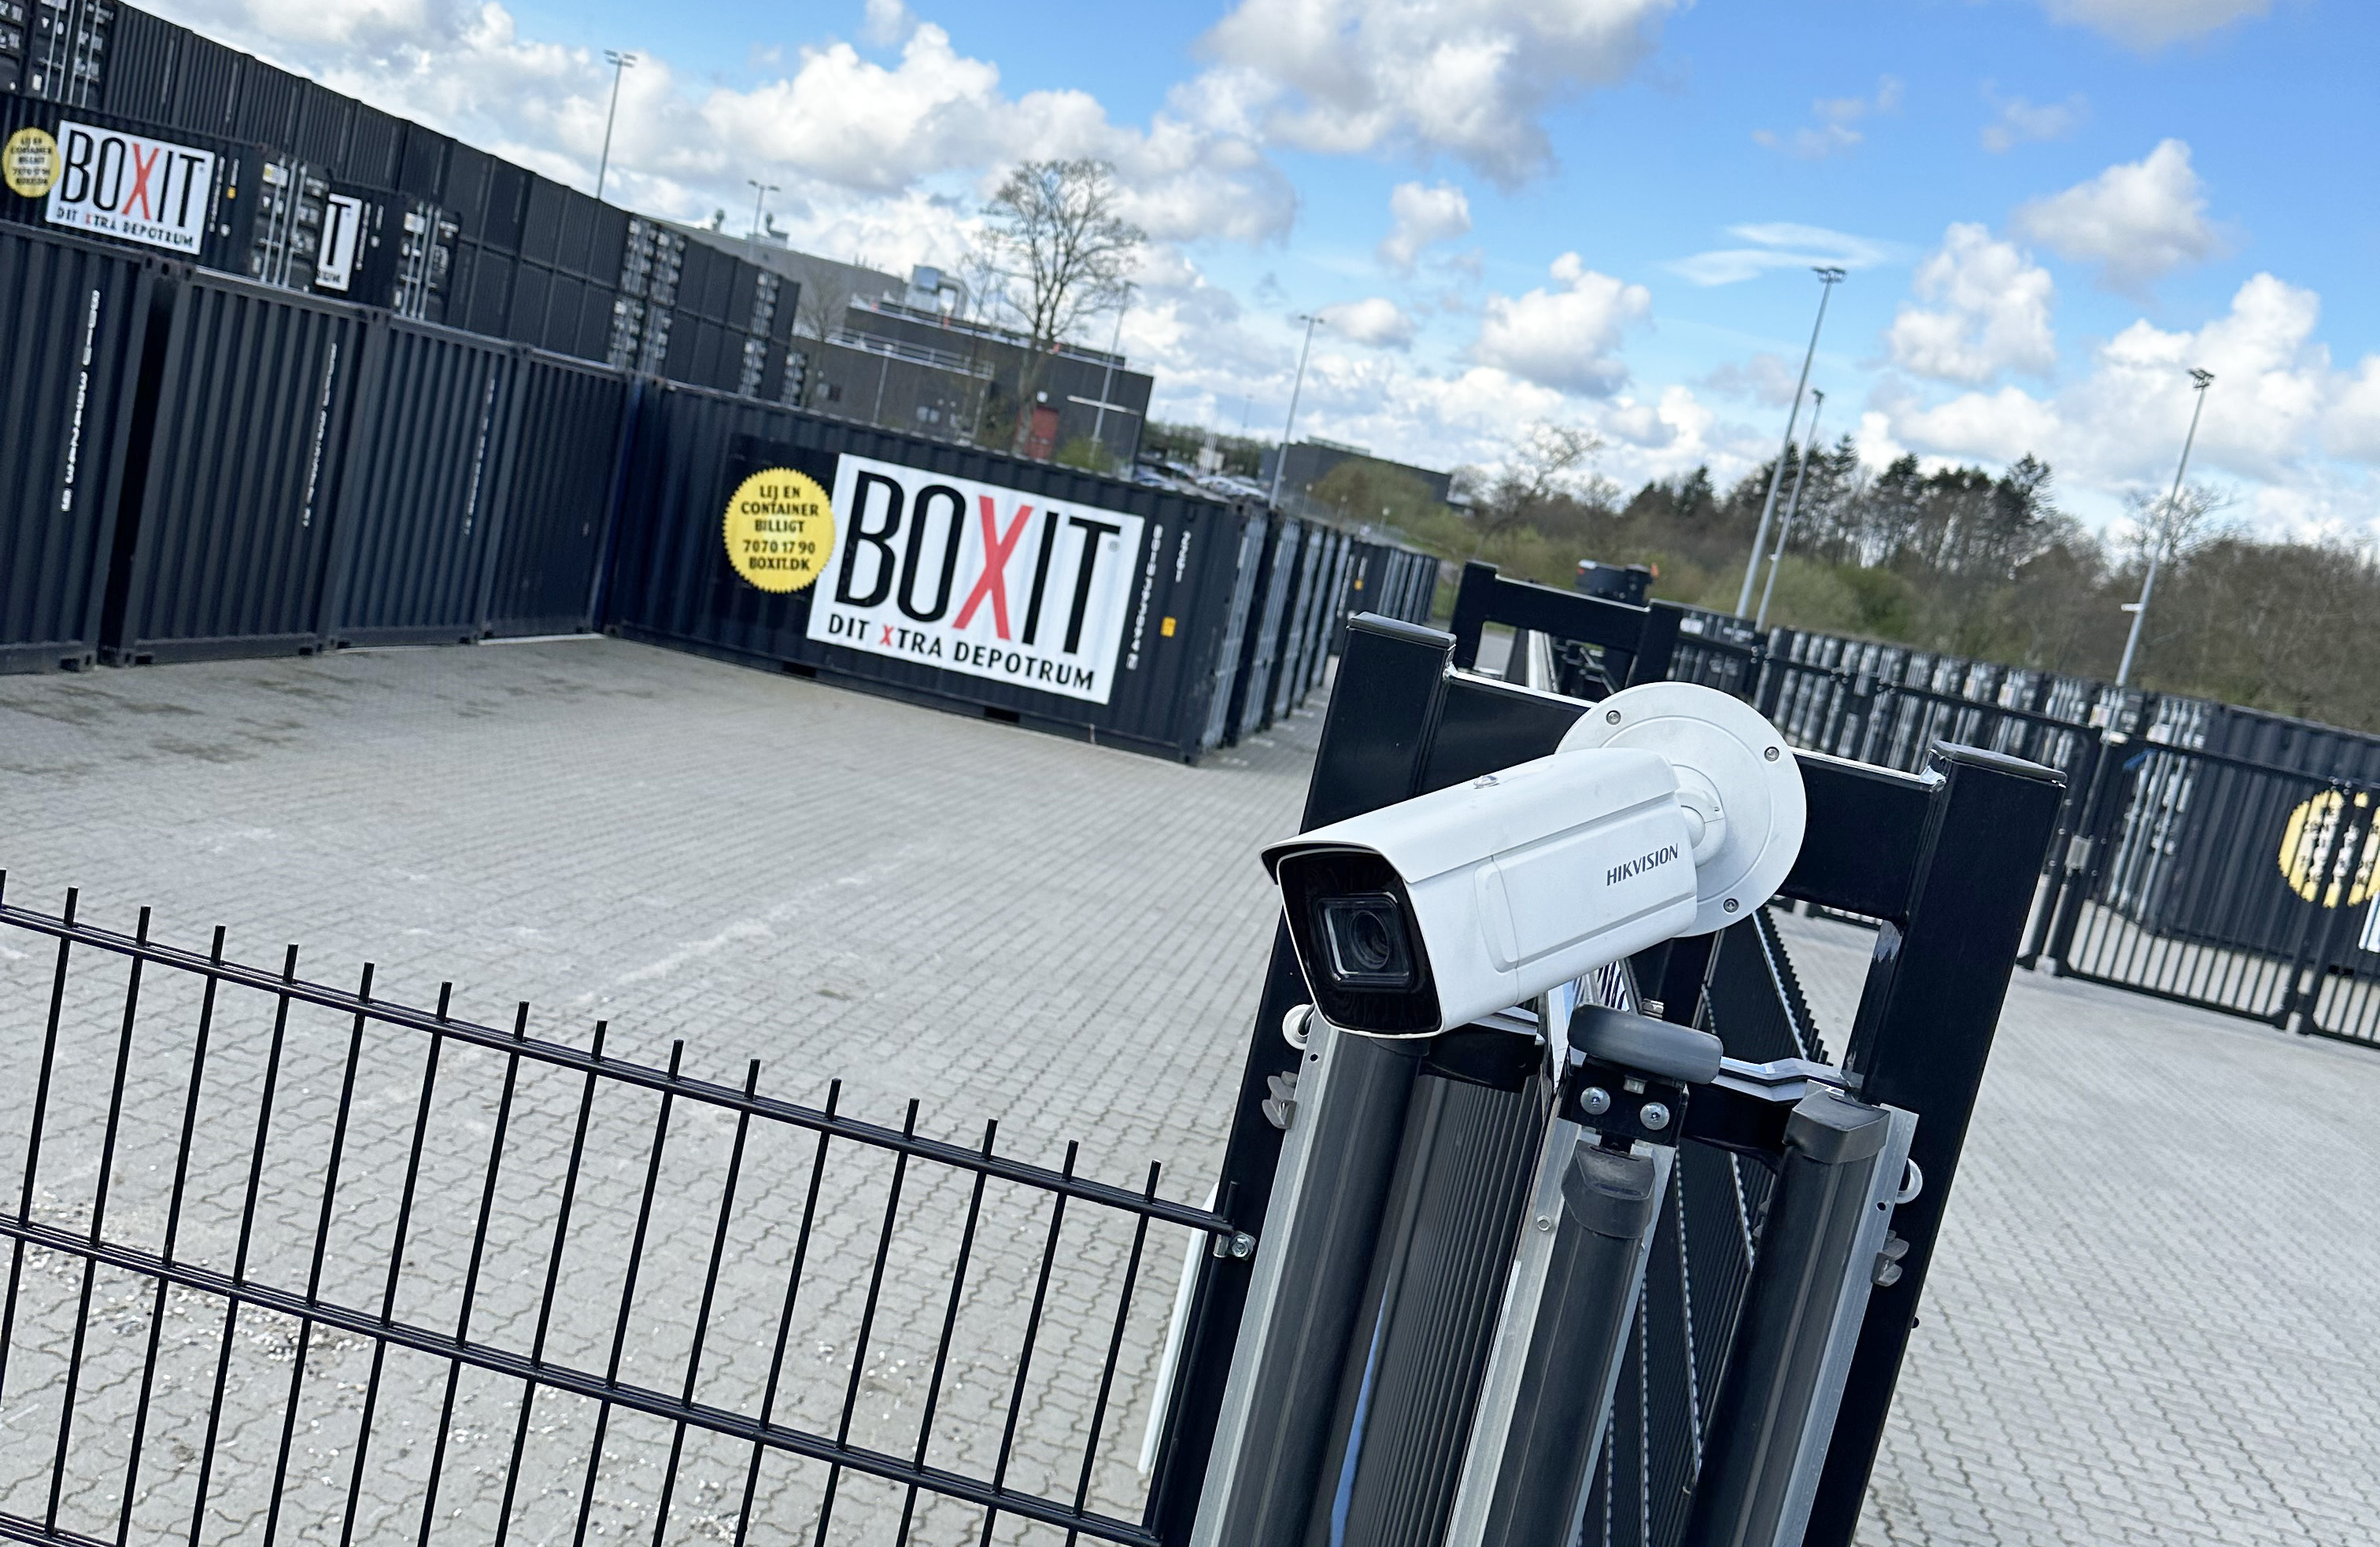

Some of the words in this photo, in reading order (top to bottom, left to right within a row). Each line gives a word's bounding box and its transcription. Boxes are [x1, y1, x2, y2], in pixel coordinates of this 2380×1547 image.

[61, 129, 205, 227] BOXIT
[741, 500, 819, 516] CONTAINER
[783, 486, 800, 498] EN
[754, 519, 804, 533] BILLIGT
[835, 471, 1121, 655] BOXIT
[829, 614, 870, 640] DIT
[879, 624, 942, 659] XTRA
[954, 641, 1095, 690] DEPOTRUM
[1606, 843, 1678, 886] HIKVISION
